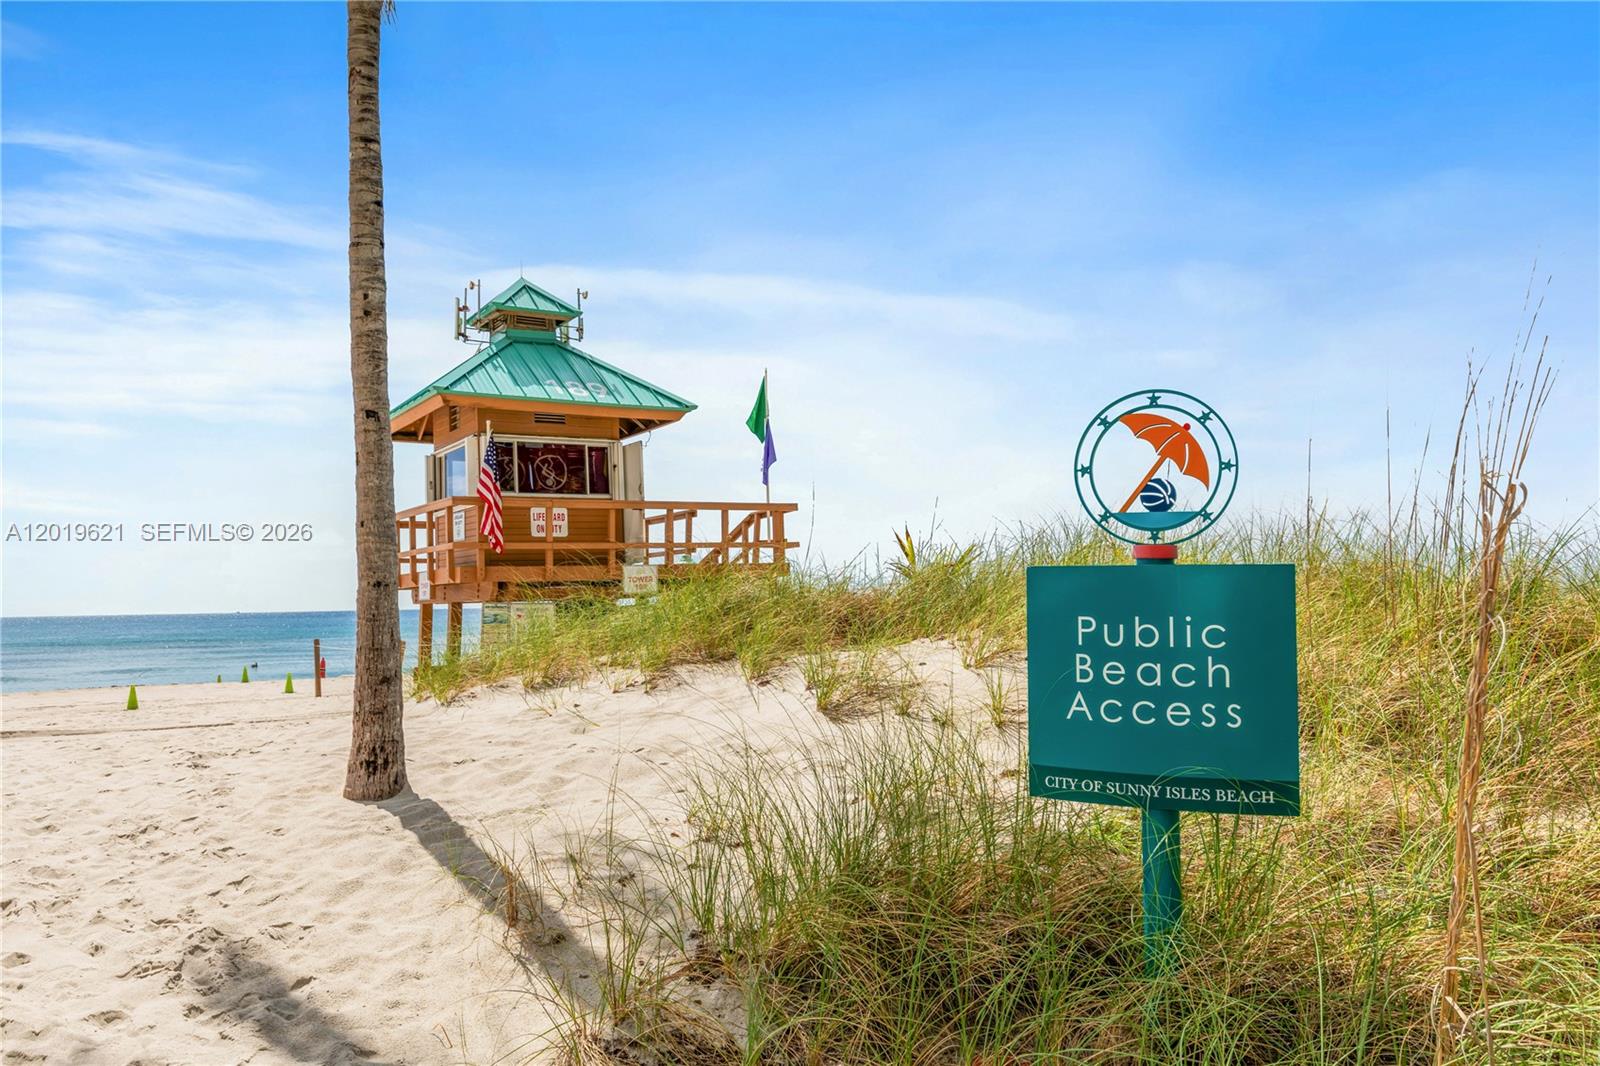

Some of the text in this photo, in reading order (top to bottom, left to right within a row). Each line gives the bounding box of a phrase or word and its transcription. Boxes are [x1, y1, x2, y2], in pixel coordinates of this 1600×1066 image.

[532, 512, 566, 521] LIFEARD
[536, 524, 545, 533] ON
[1077, 616, 1227, 648] Public
[1075, 653, 1230, 688] Beach
[1066, 691, 1242, 728] Access
[1045, 775, 1275, 804] CITY OF SUNNY ISLES BEACH
